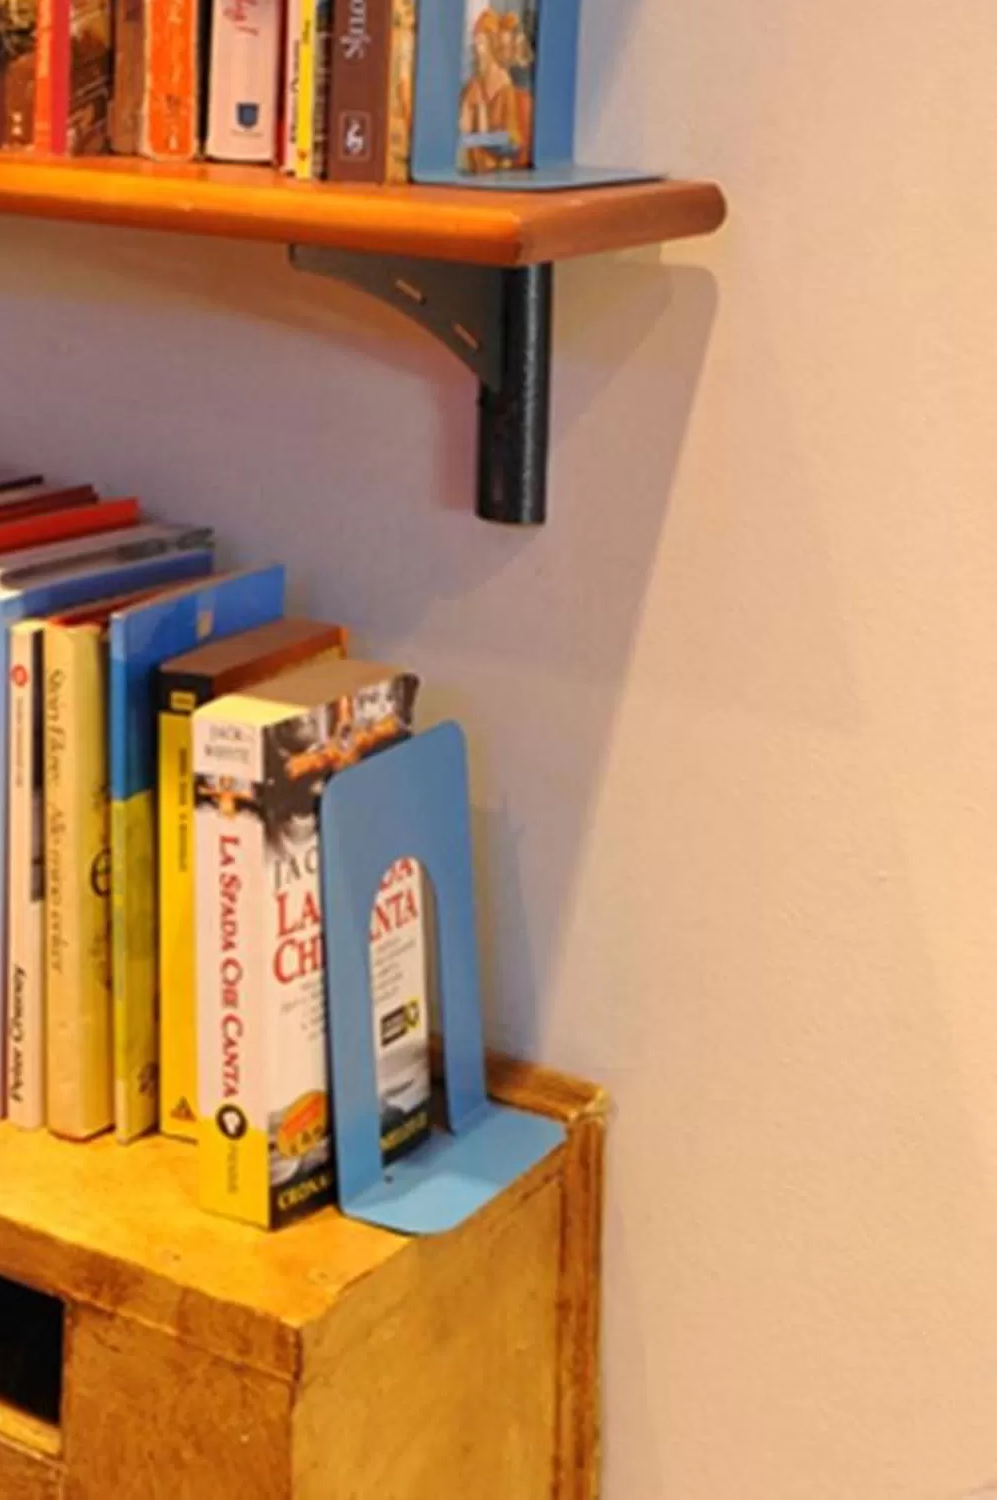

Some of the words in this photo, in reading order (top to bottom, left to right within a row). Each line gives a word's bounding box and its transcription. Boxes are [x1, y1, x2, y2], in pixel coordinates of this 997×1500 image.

[272, 845, 319, 891] JAC
[274, 891, 321, 937] LA
[272, 934, 321, 986] CH
[221, 1006, 245, 1099] CANTA
